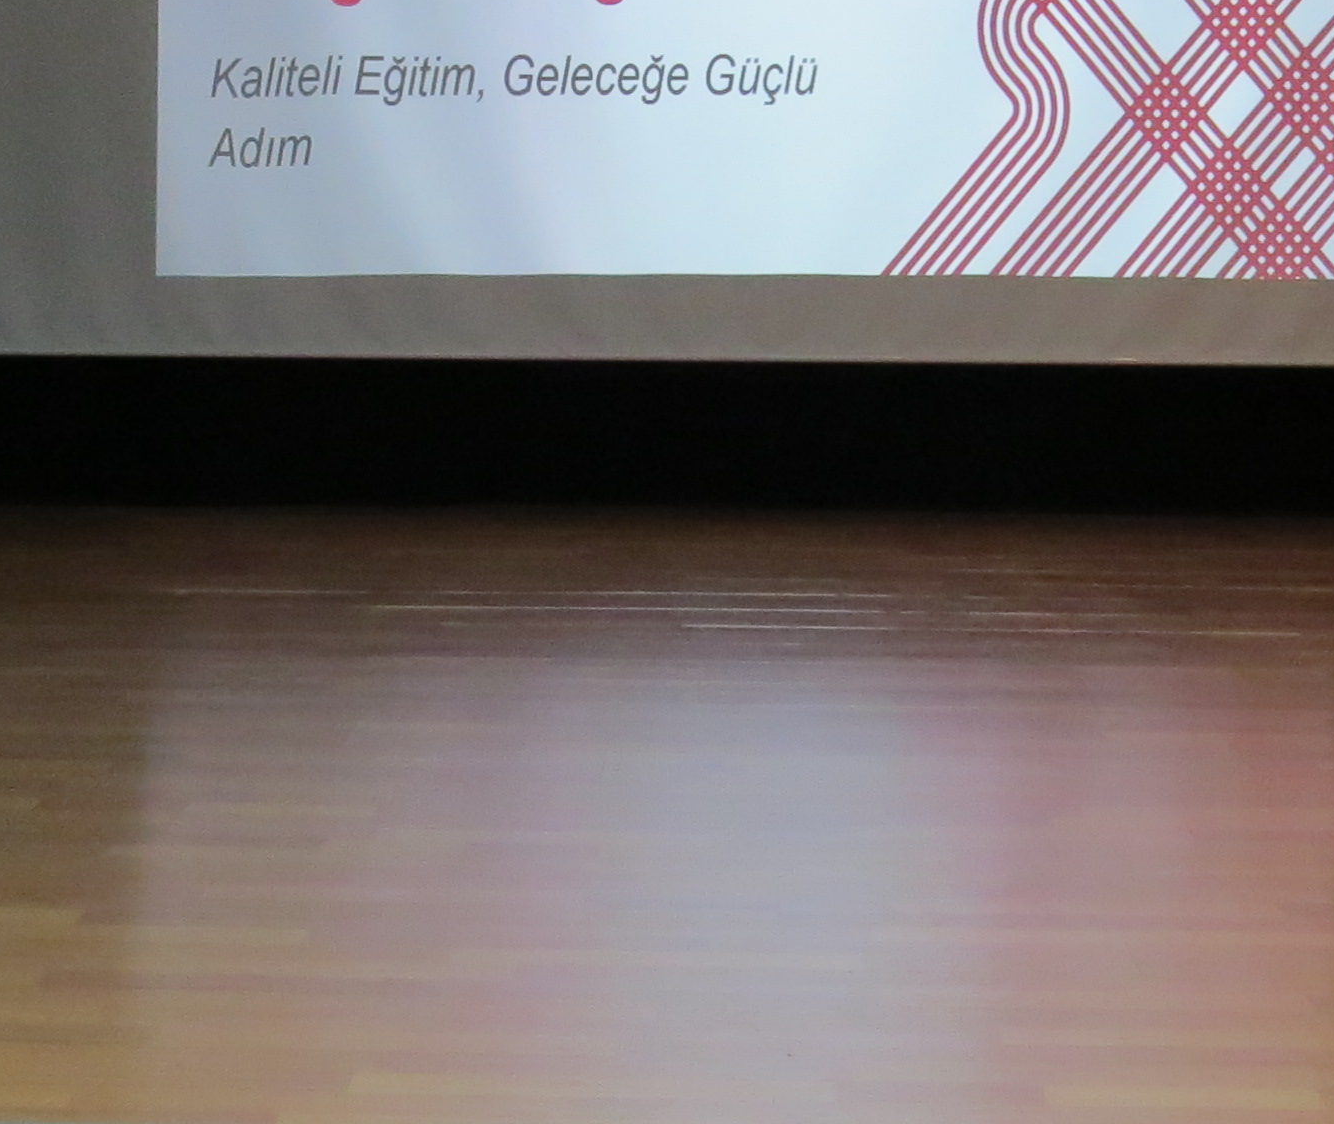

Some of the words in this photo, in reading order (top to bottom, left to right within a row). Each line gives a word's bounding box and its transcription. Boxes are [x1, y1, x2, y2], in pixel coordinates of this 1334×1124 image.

[210, 55, 343, 100] Kaliteli
[354, 55, 486, 106] Eğitim,
[503, 54, 690, 105] Geleceğe
[705, 53, 819, 106] Güçlü
[208, 127, 313, 169] Adım
